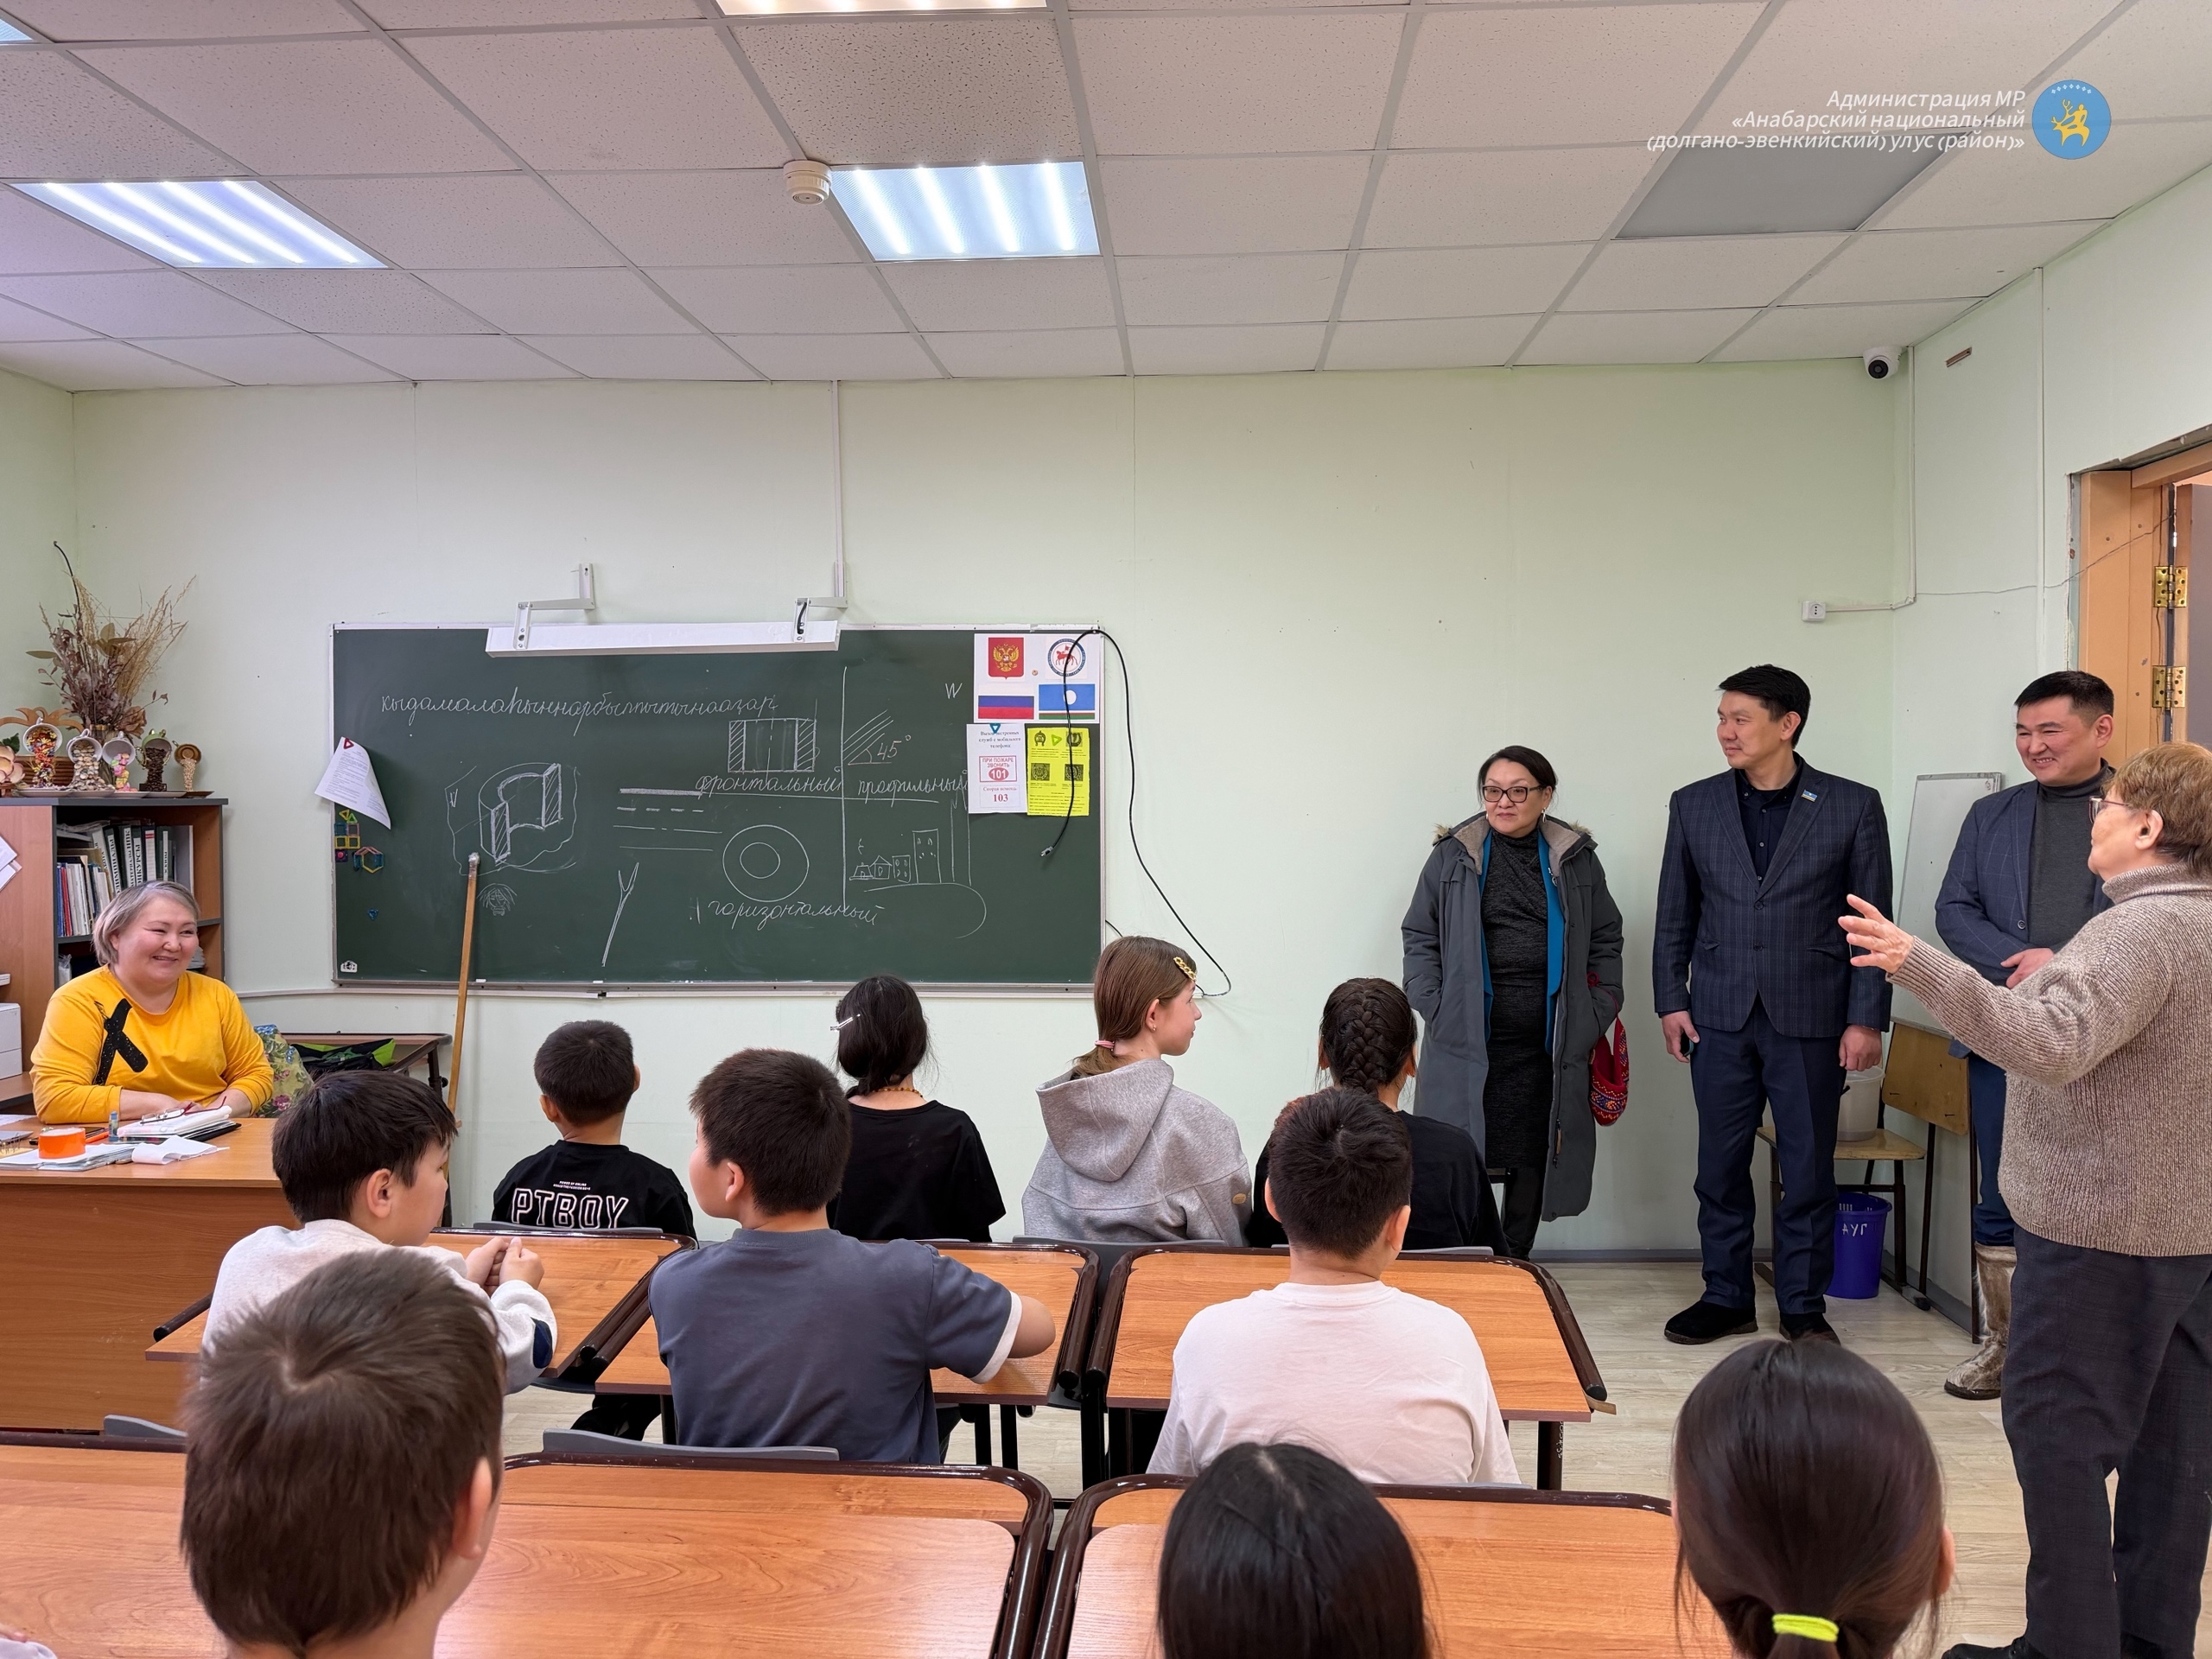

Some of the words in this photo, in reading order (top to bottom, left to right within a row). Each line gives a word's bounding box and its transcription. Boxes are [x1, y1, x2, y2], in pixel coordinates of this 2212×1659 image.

[944, 682, 963, 700] W
[991, 769, 1007, 779] 101
[993, 793, 1008, 803] 103
[134, 843, 143, 885] НКУРСЫ
[707, 899, 886, 931] горизонтальный
[511, 1187, 629, 1229] PTBOY
